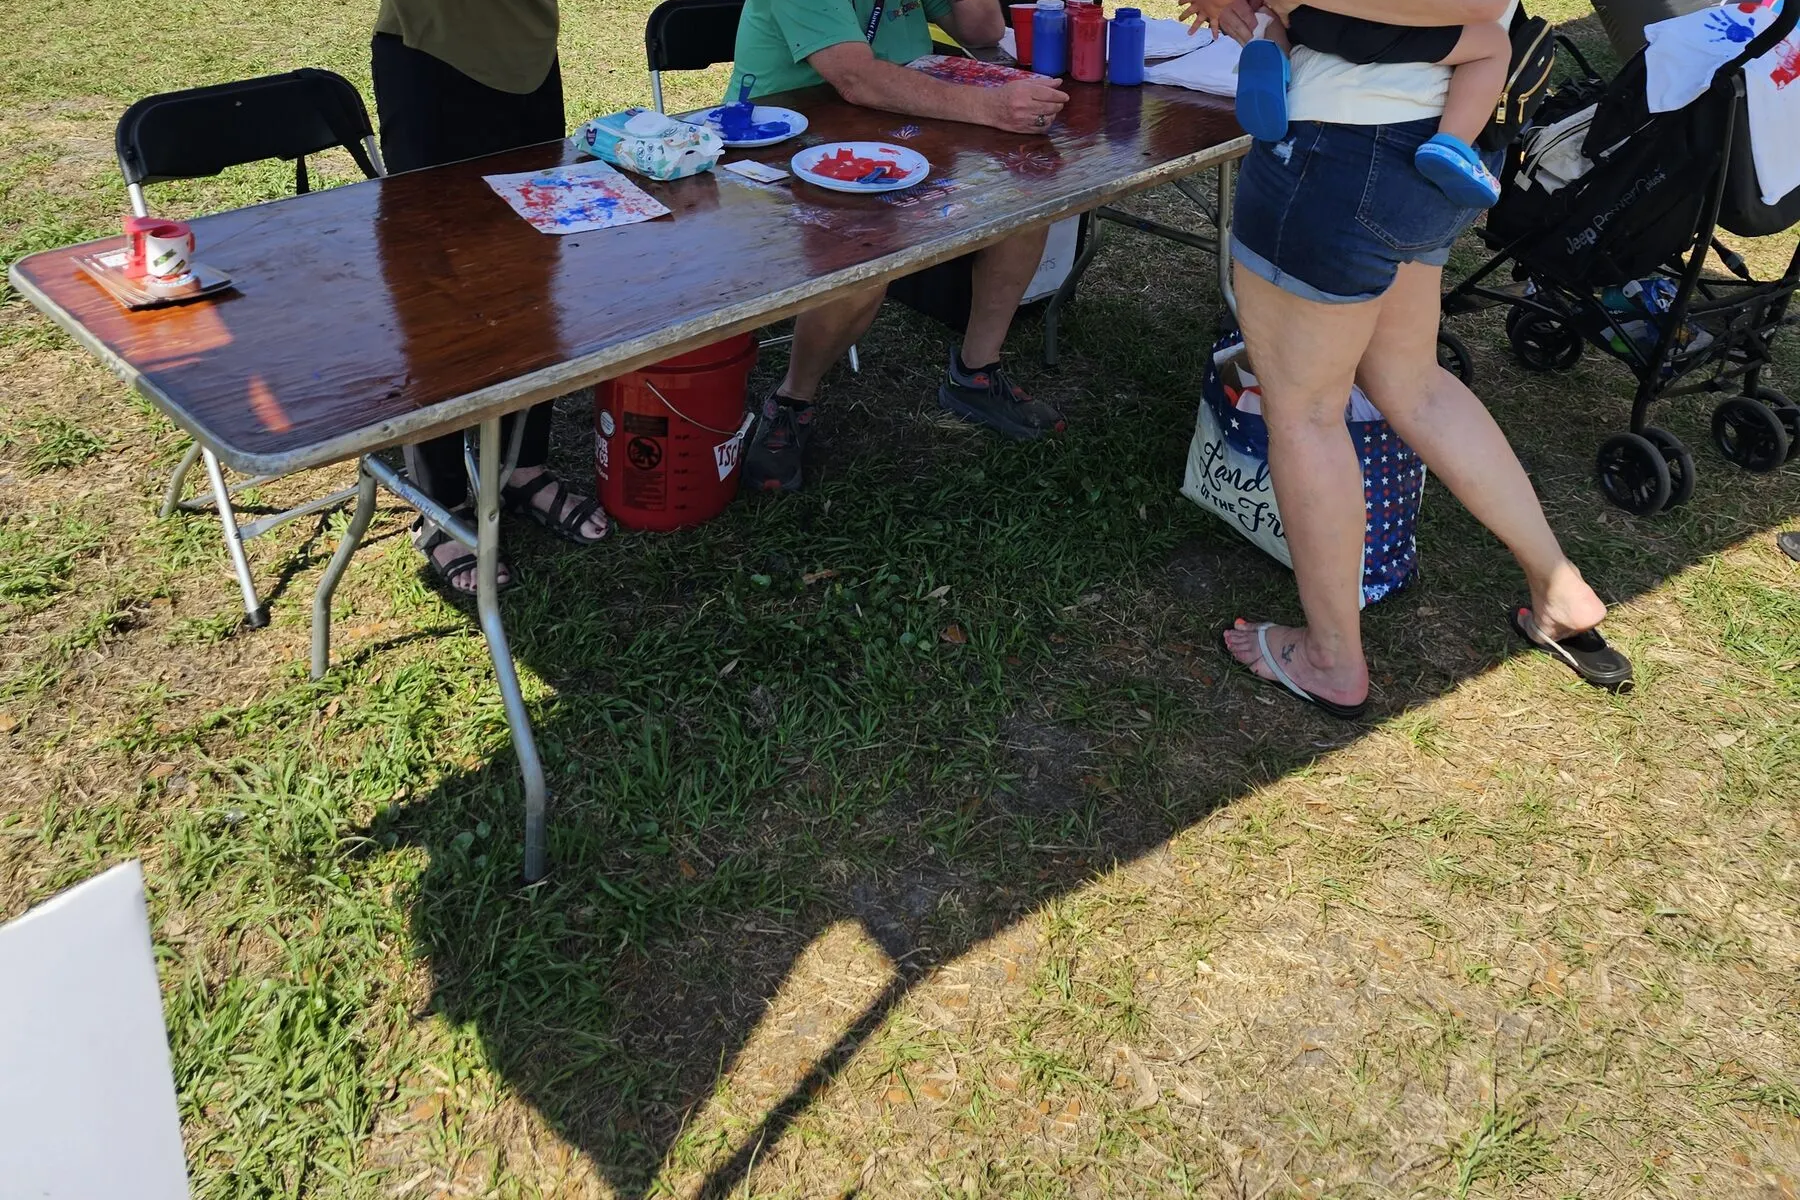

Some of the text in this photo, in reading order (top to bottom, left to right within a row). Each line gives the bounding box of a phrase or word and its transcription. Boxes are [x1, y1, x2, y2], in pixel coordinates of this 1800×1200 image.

[1566, 226, 1598, 255] Jeep
[1199, 439, 1270, 493] Land
[1211, 494, 1238, 514] THE
